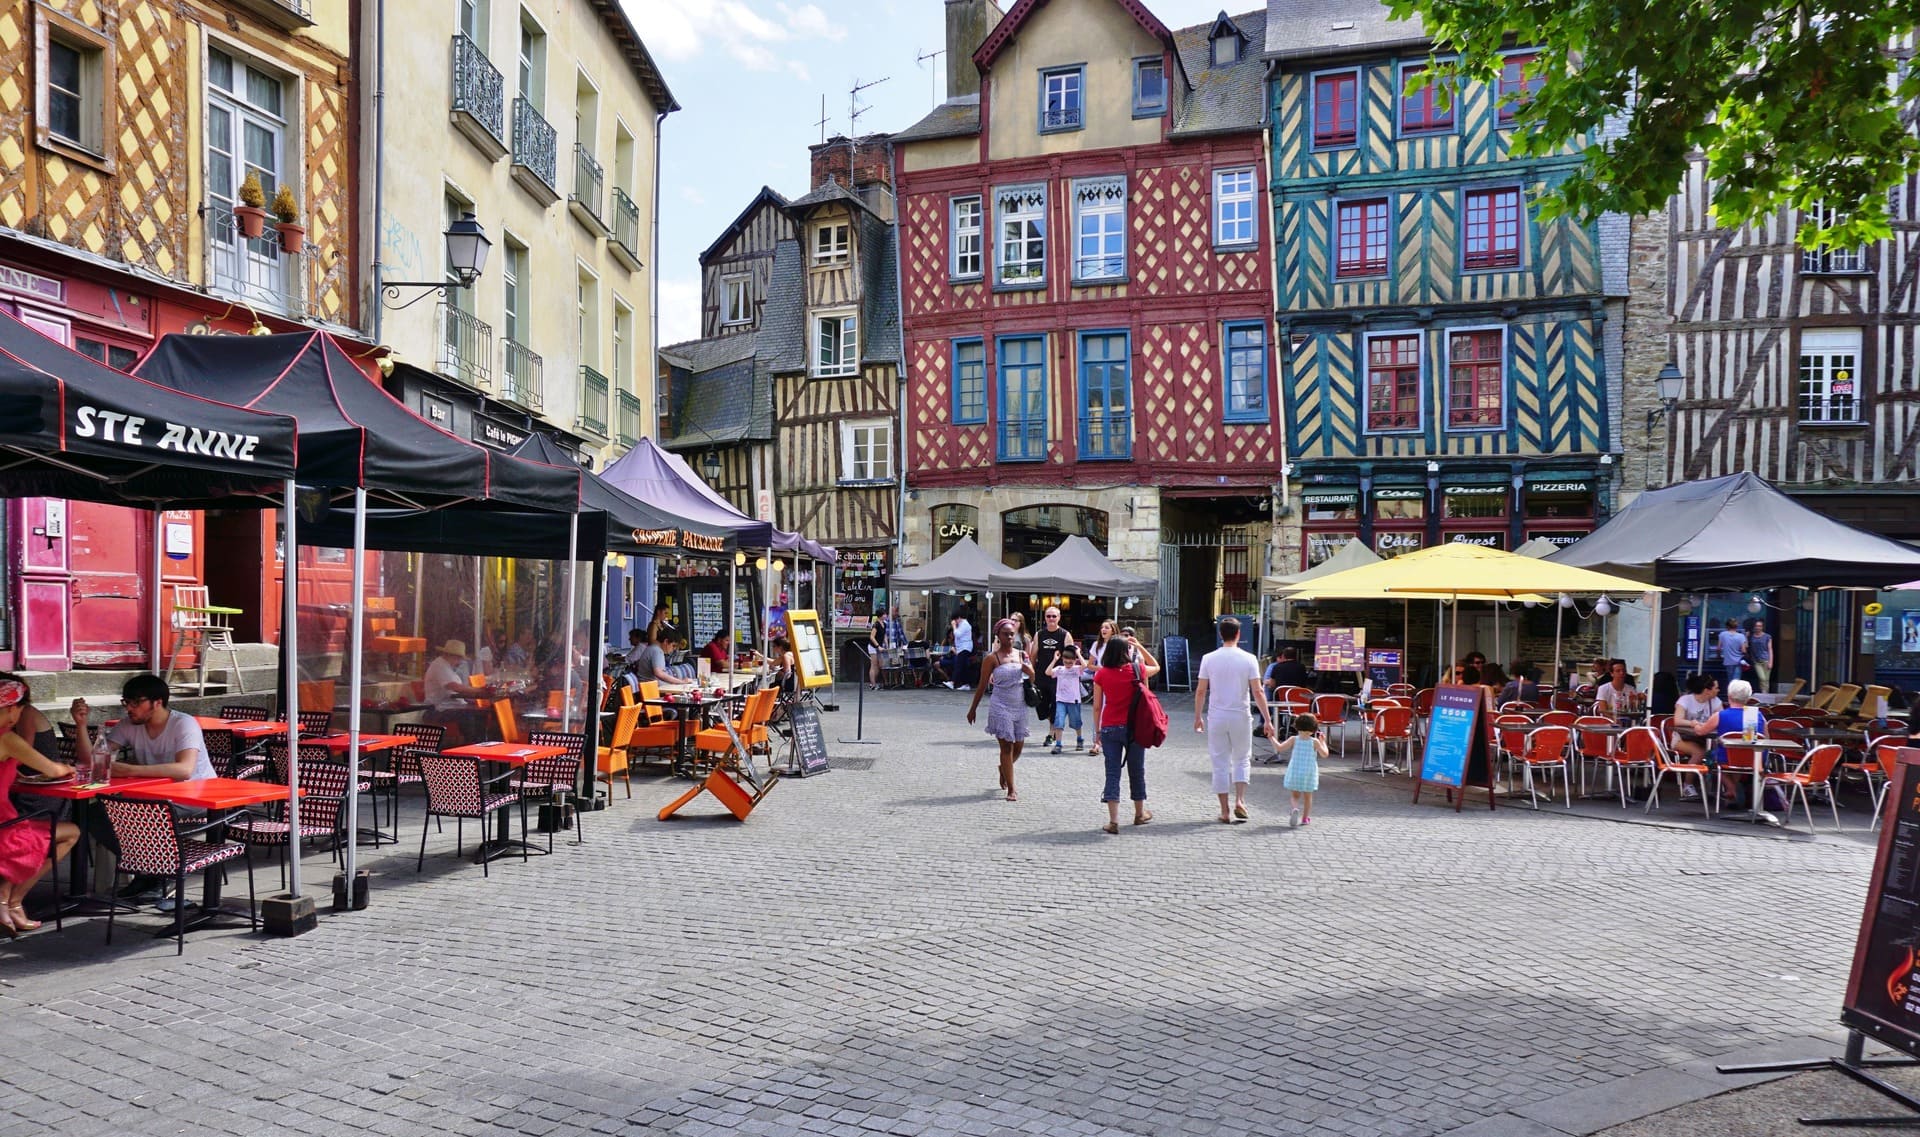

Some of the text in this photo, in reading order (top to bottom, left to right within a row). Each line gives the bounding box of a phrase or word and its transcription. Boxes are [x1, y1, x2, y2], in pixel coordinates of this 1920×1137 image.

[431, 404, 446, 420] Bar
[75, 406, 260, 461] STE ANNE
[486, 424, 500, 440] Café
[500, 429, 506, 442] le
[1376, 489, 1421, 497] Côte
[1532, 483, 1587, 492] PIZZERIA
[1304, 494, 1355, 503] RESTAURANT
[682, 530, 725, 552] PAYSANNE
[1379, 535, 1419, 549] Côte
